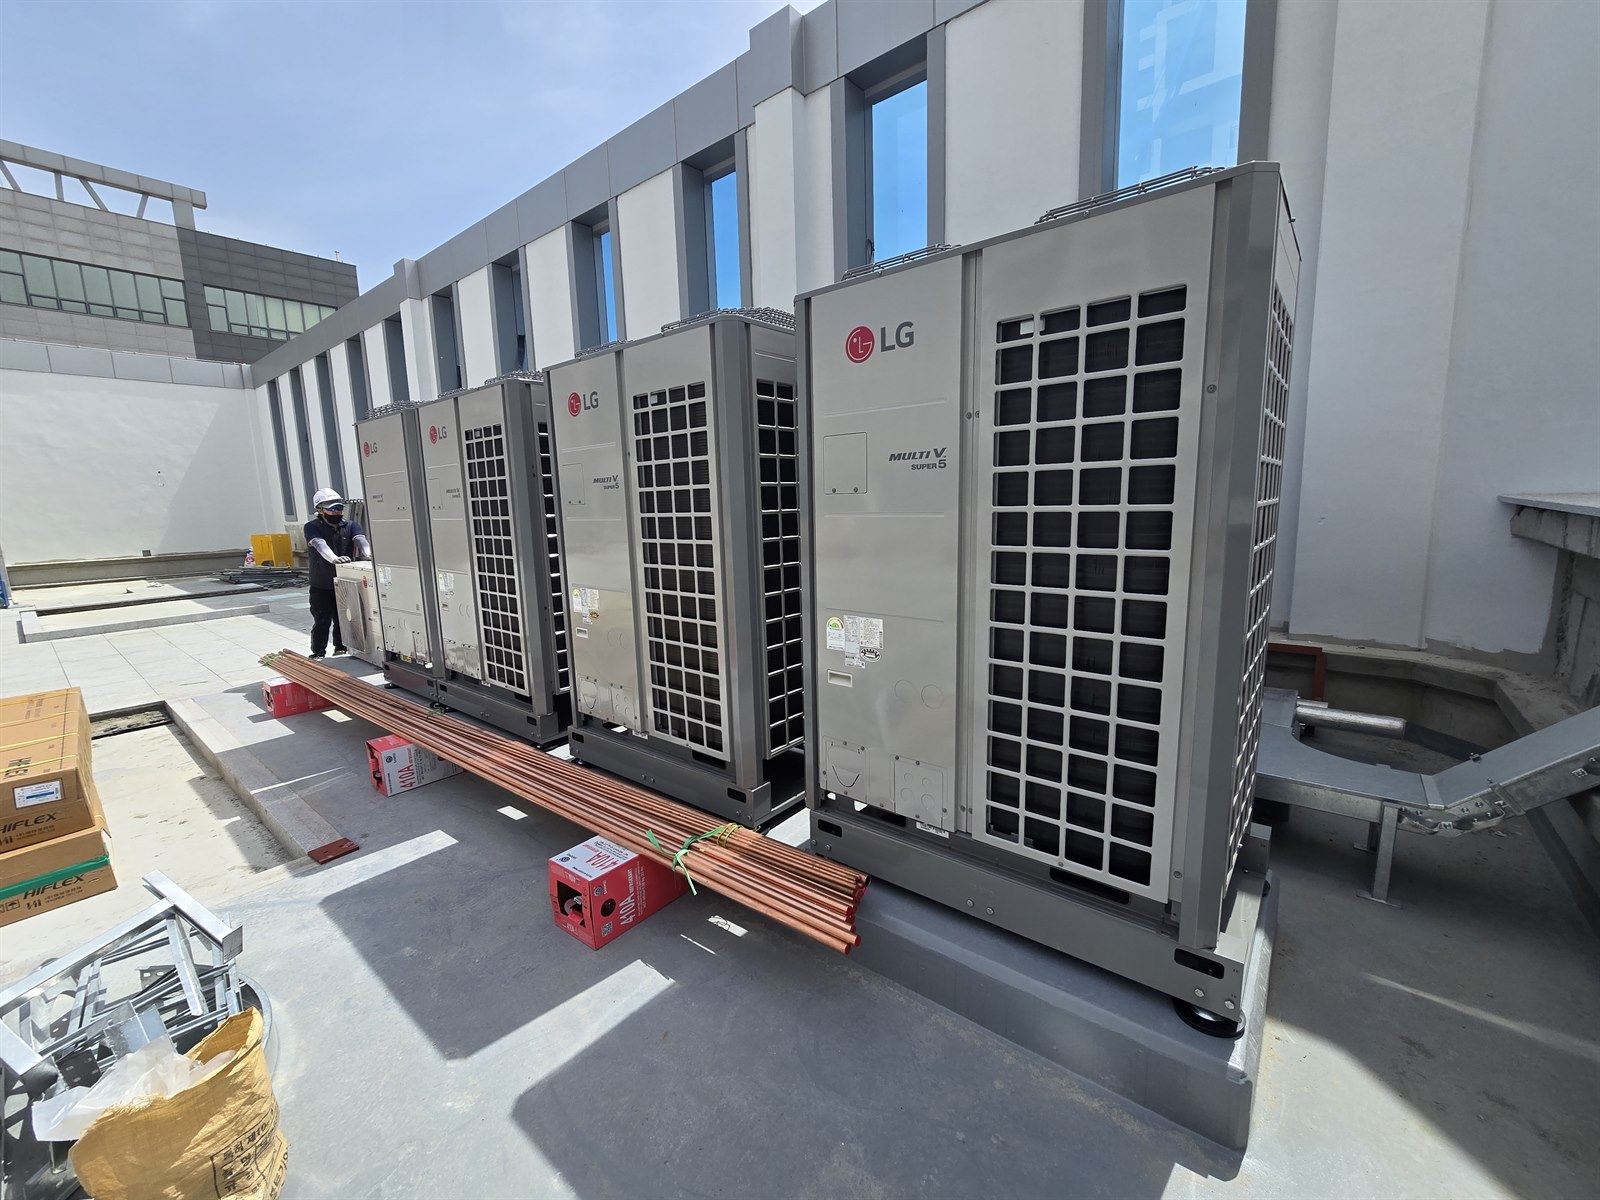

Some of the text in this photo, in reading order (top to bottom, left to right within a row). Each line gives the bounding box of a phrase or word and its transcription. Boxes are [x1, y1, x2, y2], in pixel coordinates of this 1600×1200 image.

[880, 321, 915, 353] LG
[583, 391, 599, 411] LG
[437, 426, 448, 440] LG
[370, 442, 378, 454] LG
[888, 450, 931, 462] MULTI
[911, 459, 947, 471] SUPER 5
[398, 764, 415, 788] 410A
[585, 851, 619, 871] 410A
[23, 873, 84, 900] HIFLEX
[619, 892, 636, 925] 410A
